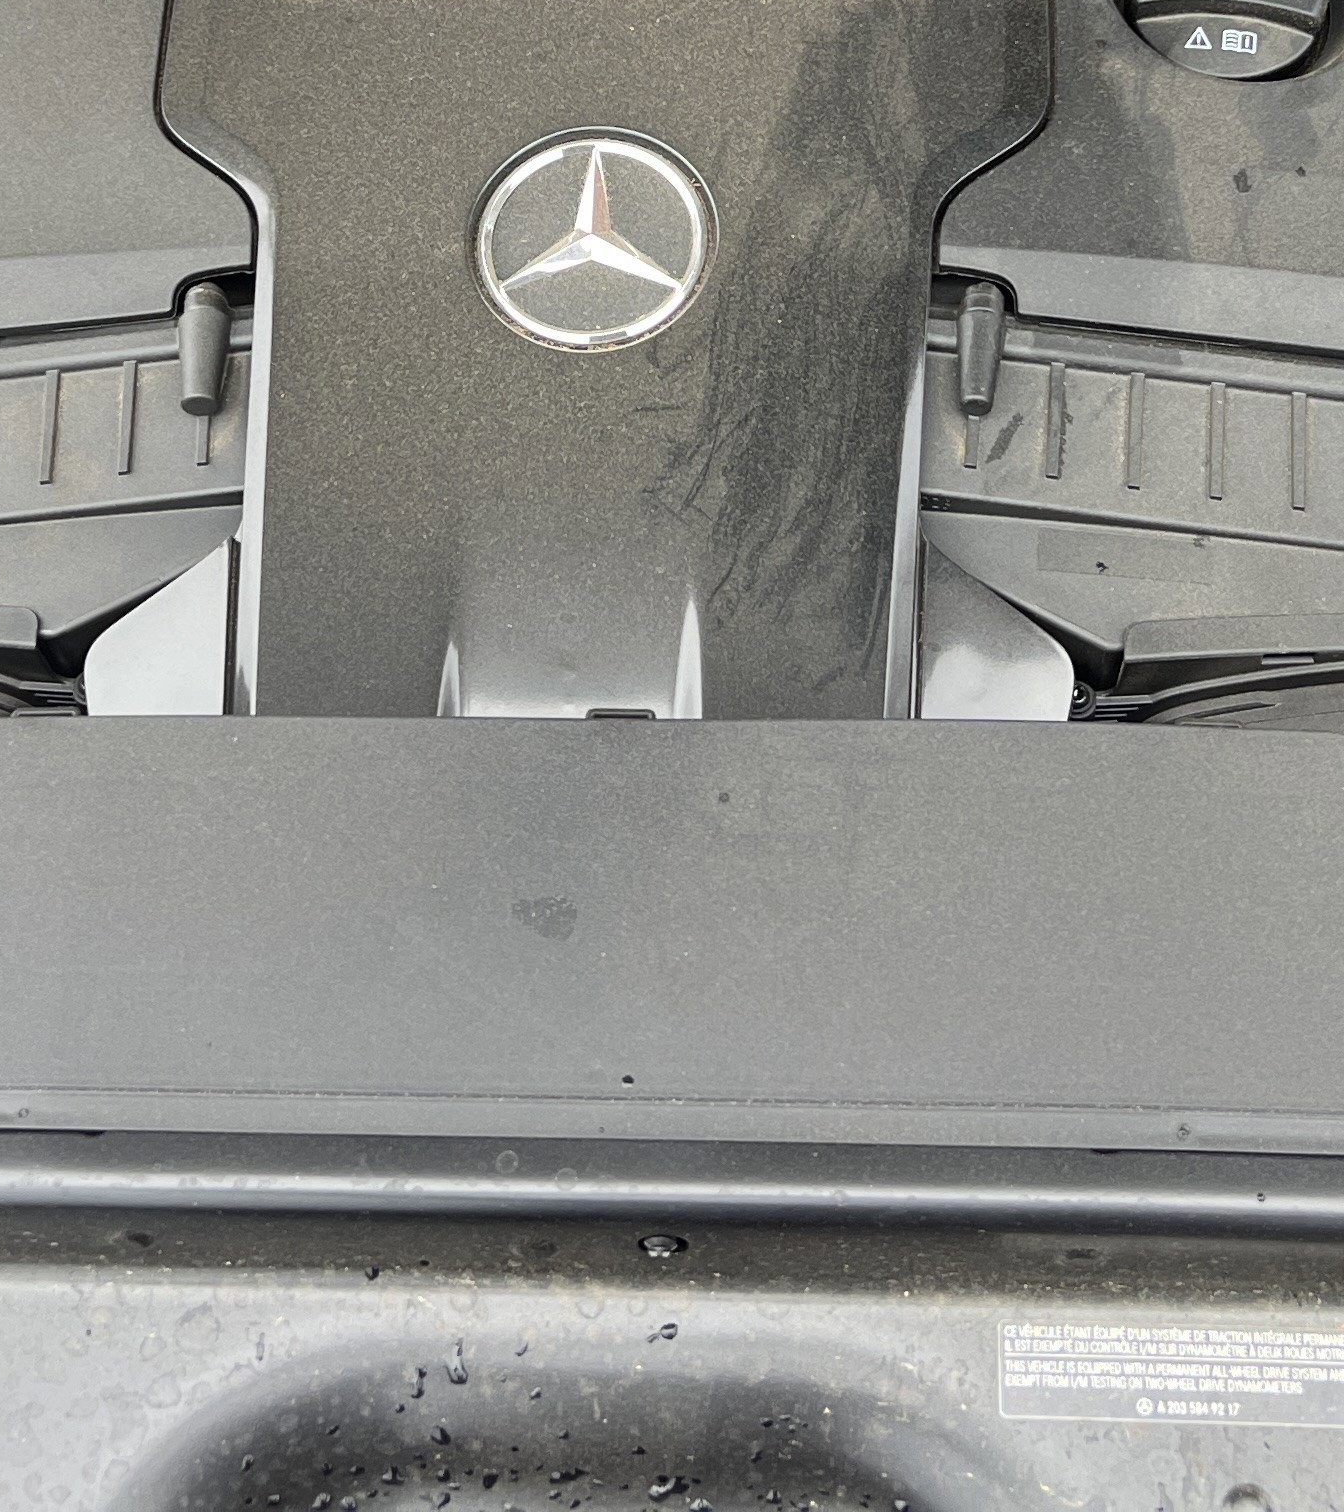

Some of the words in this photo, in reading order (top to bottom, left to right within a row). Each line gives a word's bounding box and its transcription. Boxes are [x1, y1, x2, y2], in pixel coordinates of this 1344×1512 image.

[1004, 1324, 1017, 1337] CE
[1193, 1328, 1206, 1342] DE
[1206, 1329, 1252, 1344] TRACTION
[1014, 1340, 1032, 1353] EST
[1074, 1341, 1089, 1353] DU
[1158, 1343, 1177, 1355] SUR
[1257, 1346, 1283, 1359] DEUX
[1284, 1347, 1315, 1360] ROUES
[1005, 1359, 1026, 1372] THIS
[1027, 1360, 1065, 1373] VEHICLE
[1066, 1361, 1076, 1373] IS
[1077, 1361, 1122, 1375] EQUIPPED
[1123, 1362, 1146, 1374] WITH
[1147, 1362, 1155, 1375] A
[1156, 1363, 1211, 1377] PERMANENT
[1262, 1366, 1290, 1379] DRIVE
[1291, 1367, 1327, 1381] SYSTEM
[1005, 1373, 1040, 1387] EXEMPT
[1042, 1374, 1069, 1387] FROM
[1090, 1376, 1127, 1389] TESTING
[1128, 1376, 1143, 1389] ON
[1145, 1377, 1196, 1391] TWO-WHEEL
[1198, 1378, 1226, 1392] DRIVE
[1157, 1399, 1166, 1414] A
[1167, 1400, 1187, 1414] 203
[1228, 1402, 1241, 1417] 17
